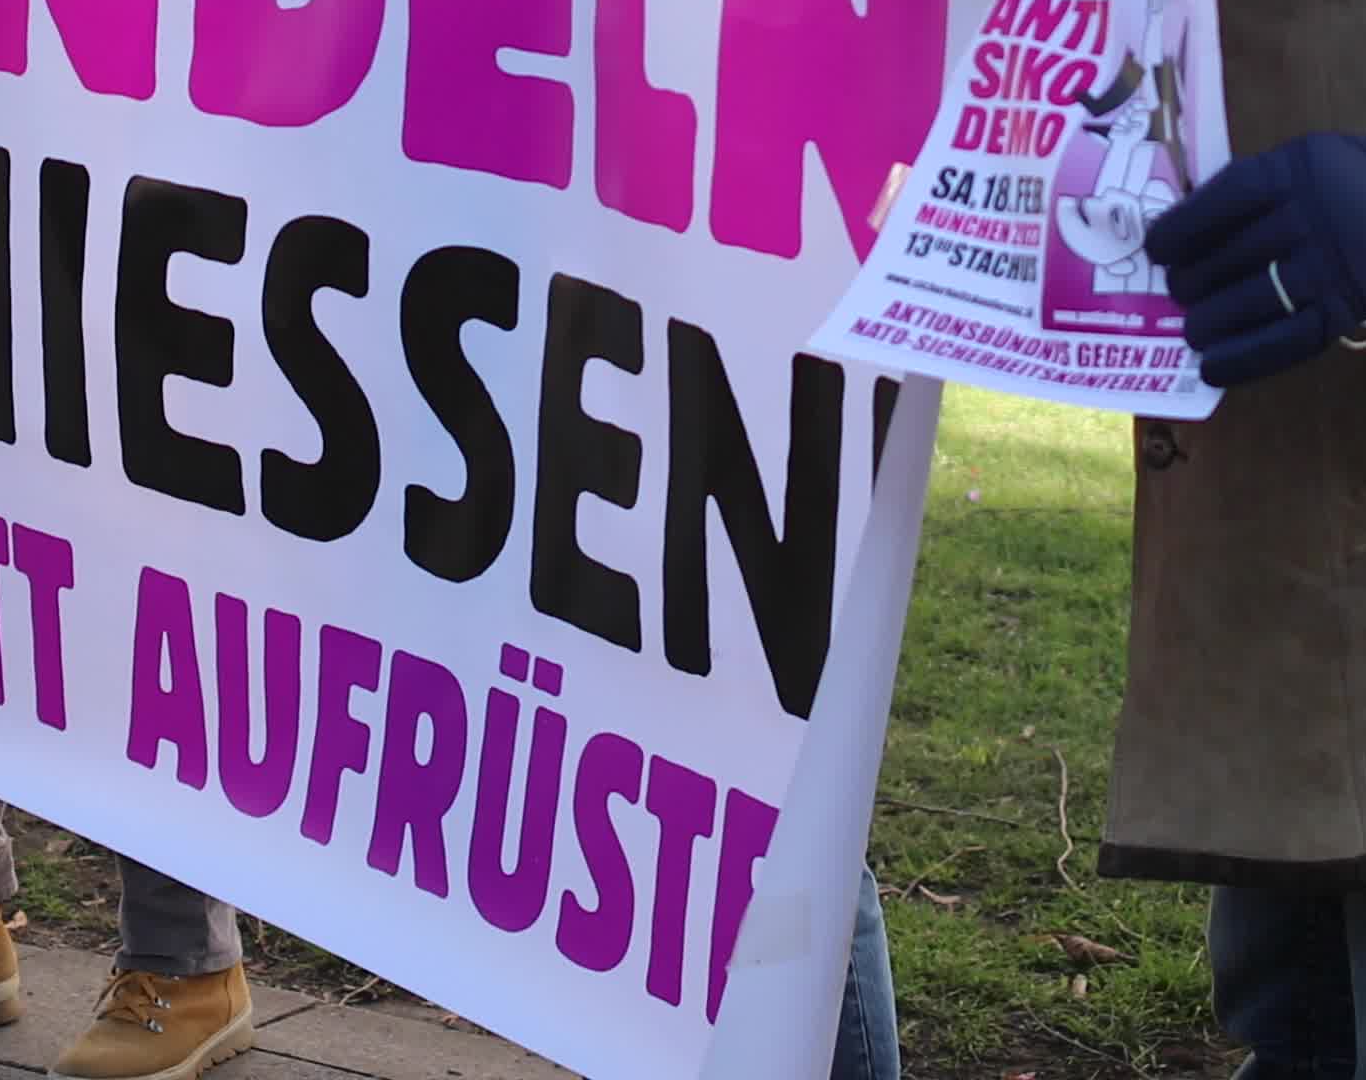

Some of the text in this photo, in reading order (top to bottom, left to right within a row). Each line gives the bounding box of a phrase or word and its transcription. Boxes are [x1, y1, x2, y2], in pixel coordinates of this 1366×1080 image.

[969, 41, 1099, 106] SIKO
[951, 106, 1066, 159] DEMO
[849, 316, 1176, 393] NATO-SICHERHEITSKONFERENZ
[883, 299, 1071, 367] AKTIONSBÜNDNIS
[1077, 342, 1144, 369] GEGEN
[1149, 345, 1184, 370] DIE
